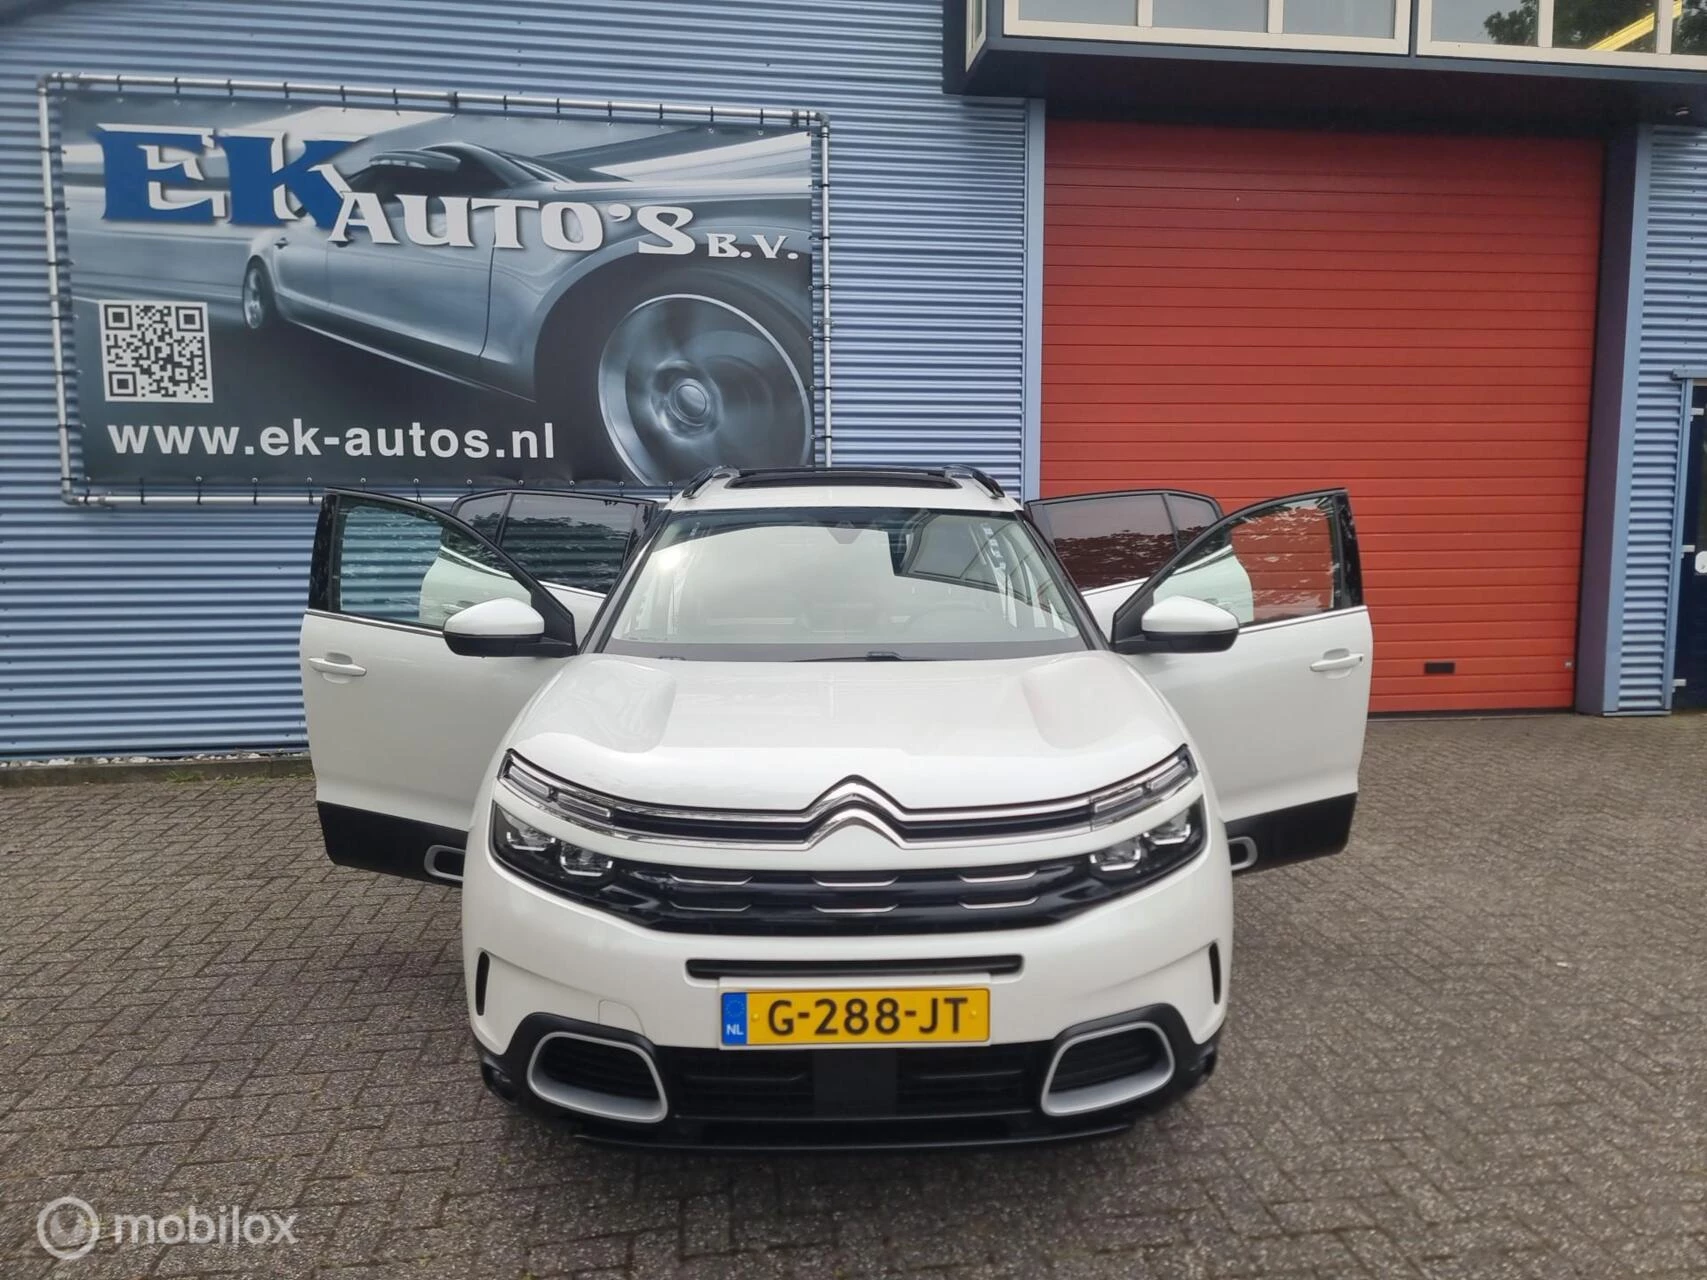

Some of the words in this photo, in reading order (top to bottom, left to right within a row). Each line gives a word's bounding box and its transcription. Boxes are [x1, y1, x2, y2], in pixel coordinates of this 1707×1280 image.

[96, 122, 366, 231] EK
[328, 190, 695, 256] AUTO'S
[705, 232, 799, 260] B.V.
[107, 418, 555, 460] www.ek-autos.nl
[726, 1024, 744, 1036] NL
[768, 997, 968, 1036] G-288-JT
